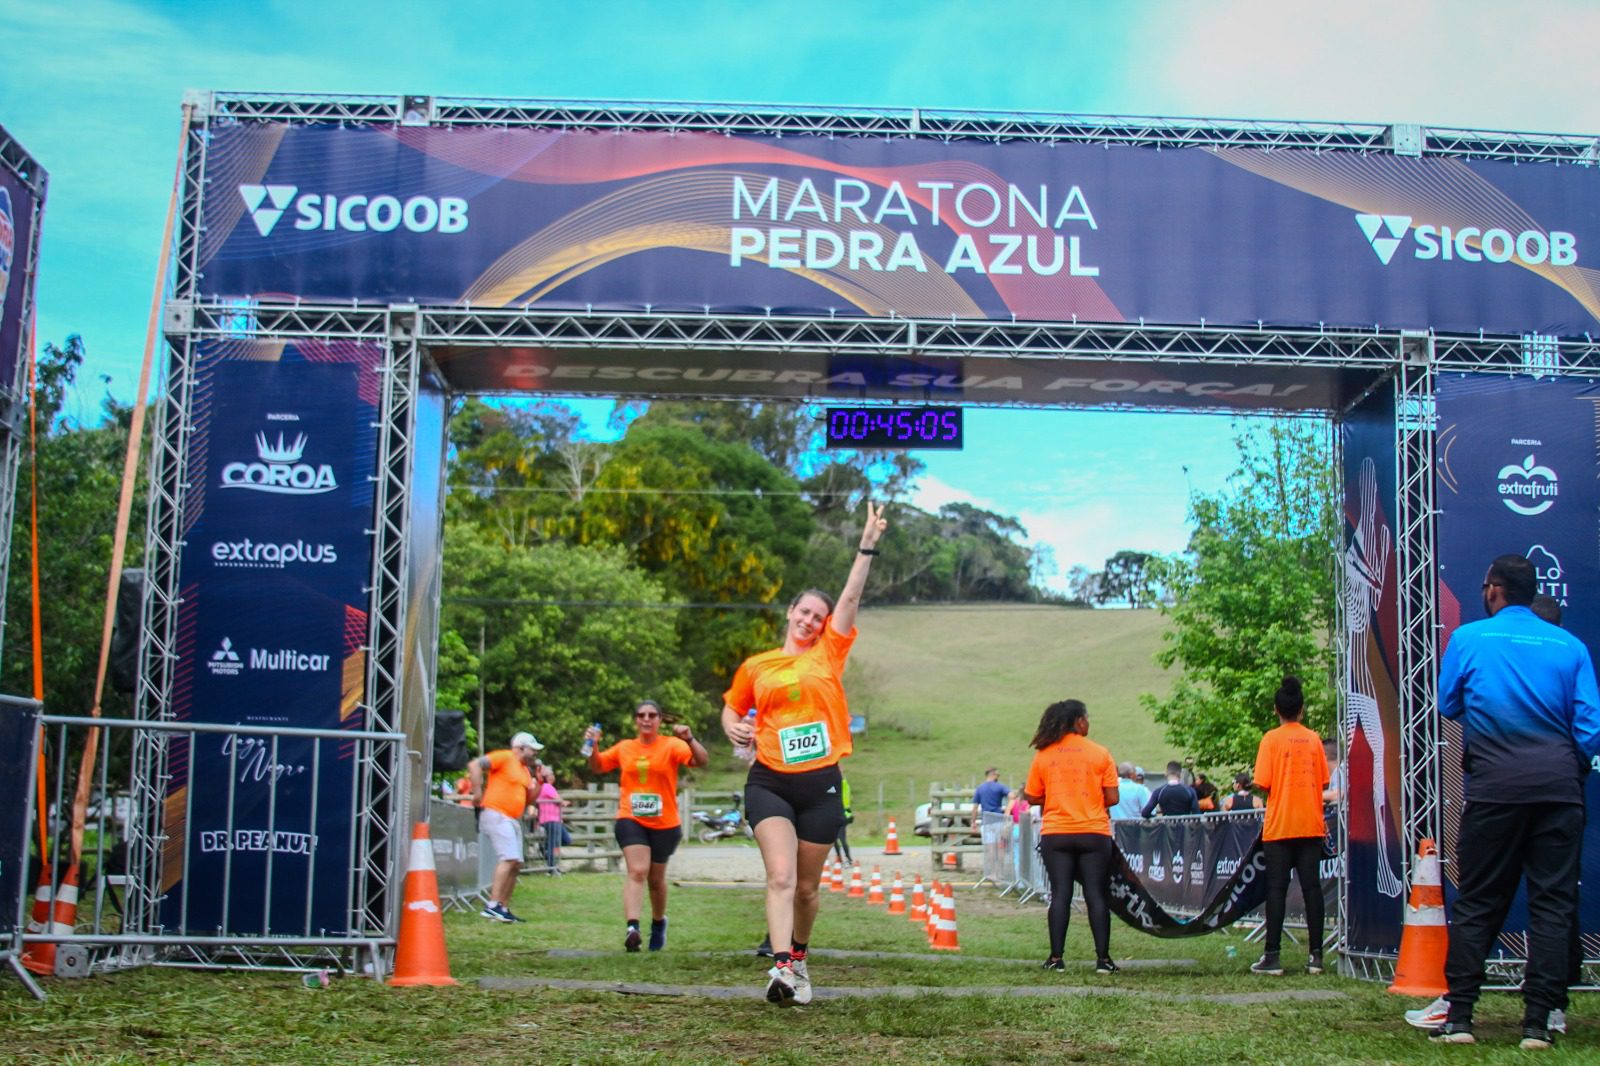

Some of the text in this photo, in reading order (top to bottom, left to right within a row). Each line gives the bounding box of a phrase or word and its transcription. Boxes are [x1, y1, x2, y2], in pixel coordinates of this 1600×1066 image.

[295, 193, 469, 233] SICOOB
[732, 176, 1098, 230] MARATONA
[730, 227, 1100, 276] PEDRA AZUL
[1413, 224, 1578, 266] SICOOB
[503, 364, 1306, 397] DESCUBRA SUA FORÇA!
[830, 411, 958, 440] 00:45:05
[1510, 438, 1542, 446] PARCERIA
[221, 461, 337, 489] COROA
[1498, 481, 1559, 499] extrafruti
[211, 538, 338, 567] extraplus
[1535, 567, 1560, 580] LO
[250, 648, 330, 671] Multicar
[788, 735, 818, 751] 5102
[235, 830, 319, 855] PEANUT
